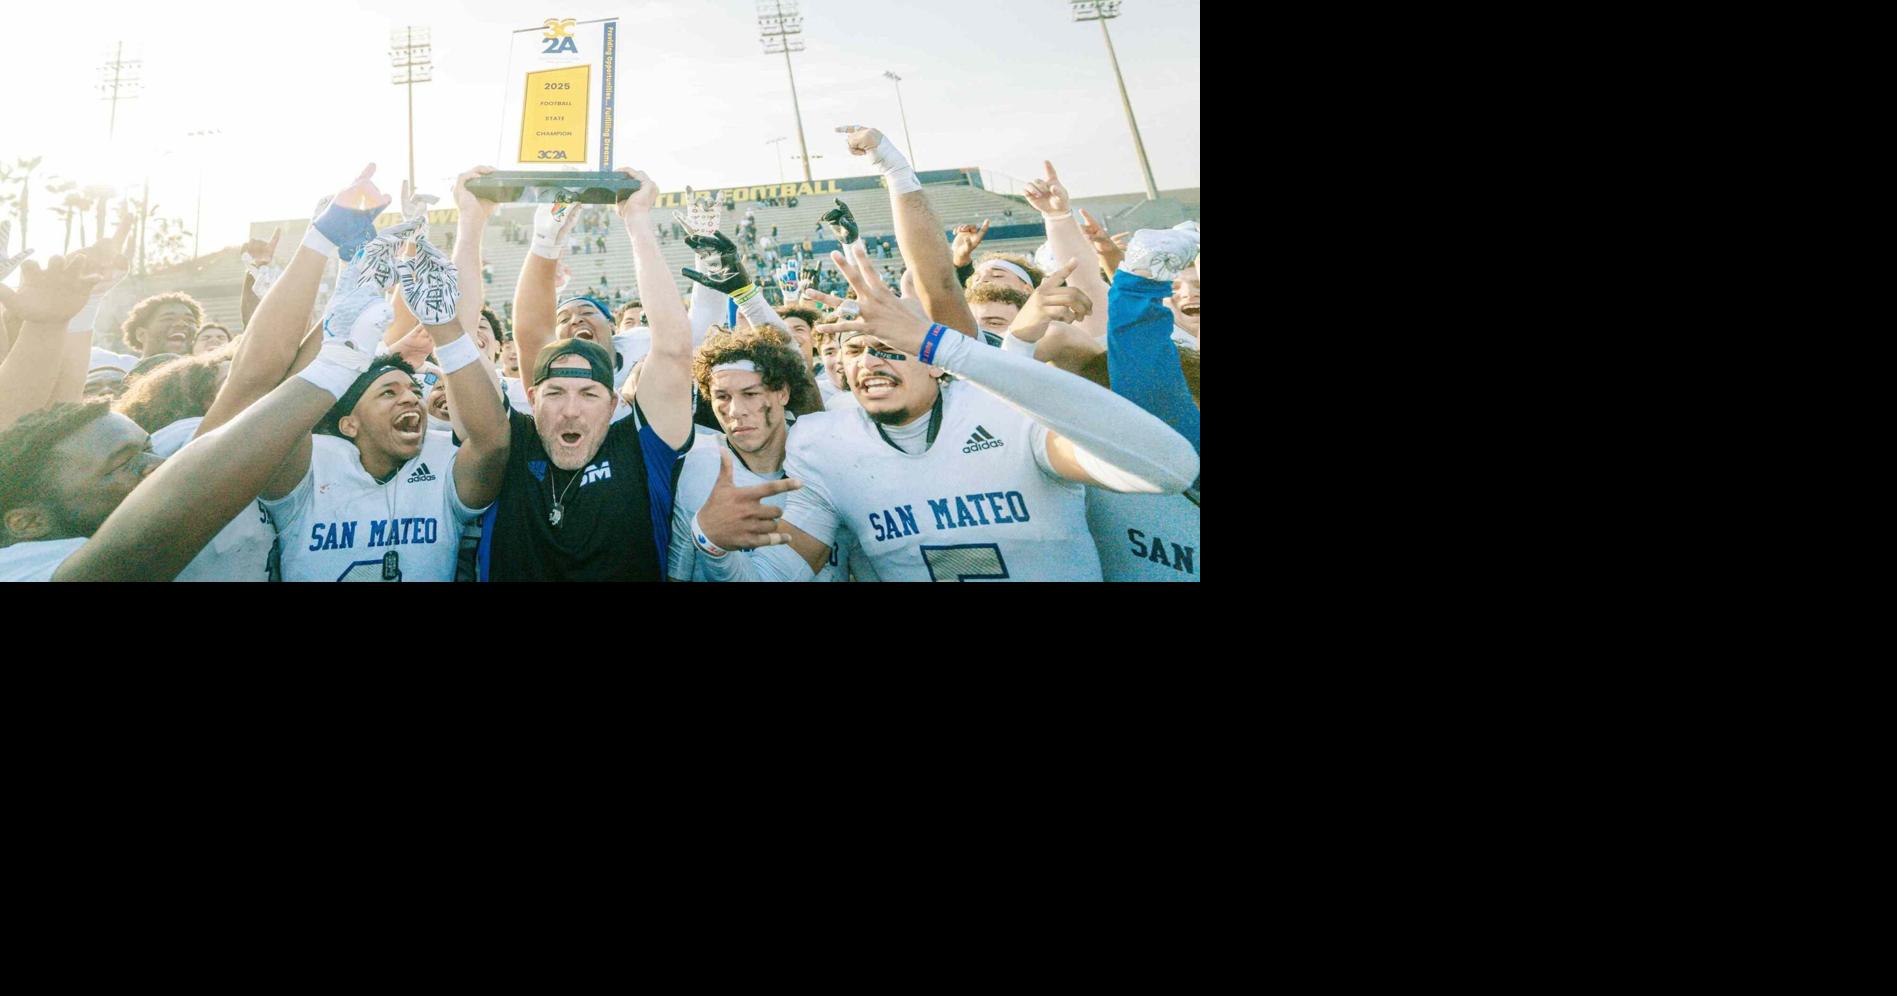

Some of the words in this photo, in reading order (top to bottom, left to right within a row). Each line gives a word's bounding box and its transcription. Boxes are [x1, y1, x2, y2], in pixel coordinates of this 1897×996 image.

[541, 36, 578, 54] 2A
[544, 82, 571, 90] 2025
[537, 150, 568, 159] 3C2A
[722, 179, 843, 202] FOOTBALL
[962, 437, 1004, 454] adidas
[407, 474, 436, 484] adidas
[869, 504, 920, 542] SAN
[927, 490, 1031, 530] MATEO
[309, 520, 358, 552] SAN
[367, 517, 438, 548] MATEO
[1127, 527, 1195, 575] SAN
